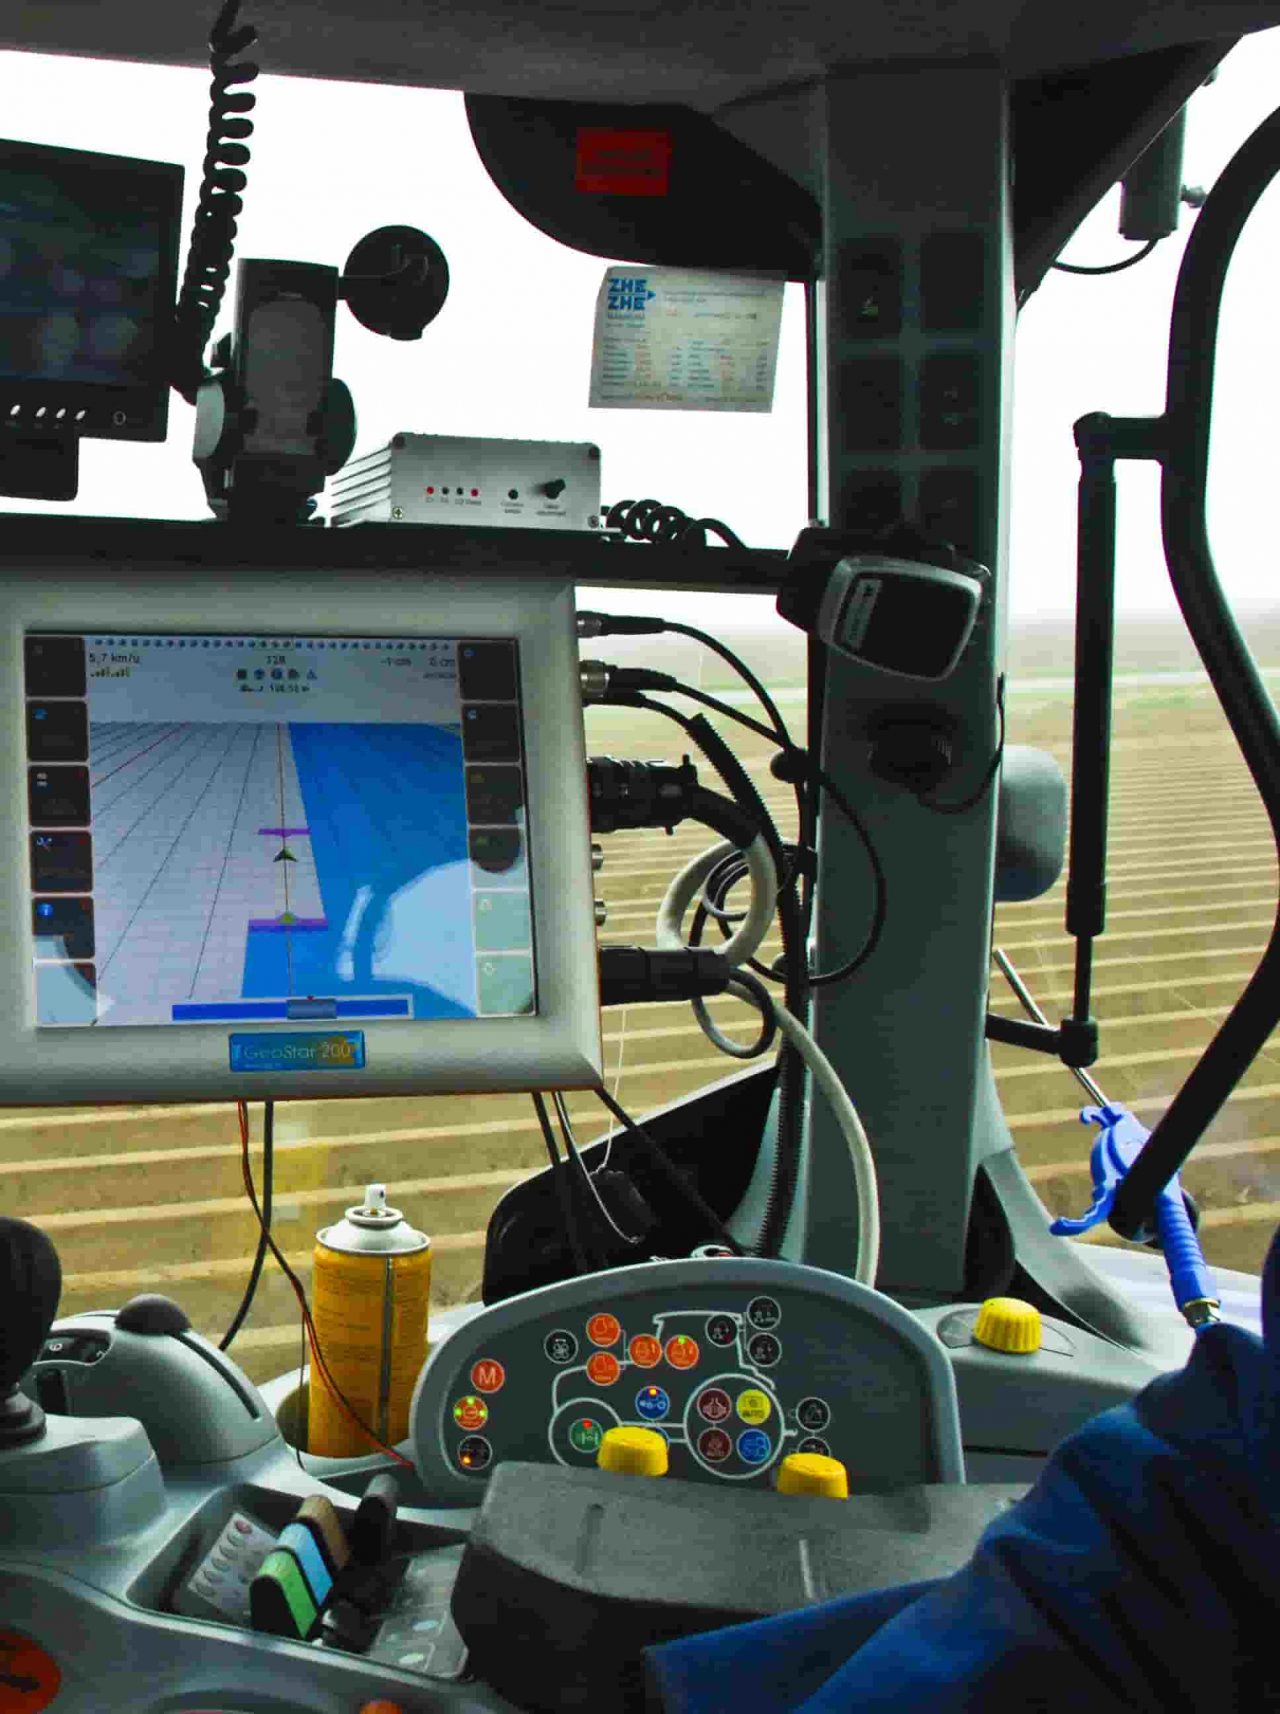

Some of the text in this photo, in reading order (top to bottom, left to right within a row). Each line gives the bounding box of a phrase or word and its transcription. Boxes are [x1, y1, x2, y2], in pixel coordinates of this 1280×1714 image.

[608, 278, 647, 293] ZHE
[607, 296, 646, 311] ZHE
[243, 1042, 351, 1059] GeoStar 200
[478, 1365, 497, 1386] M
